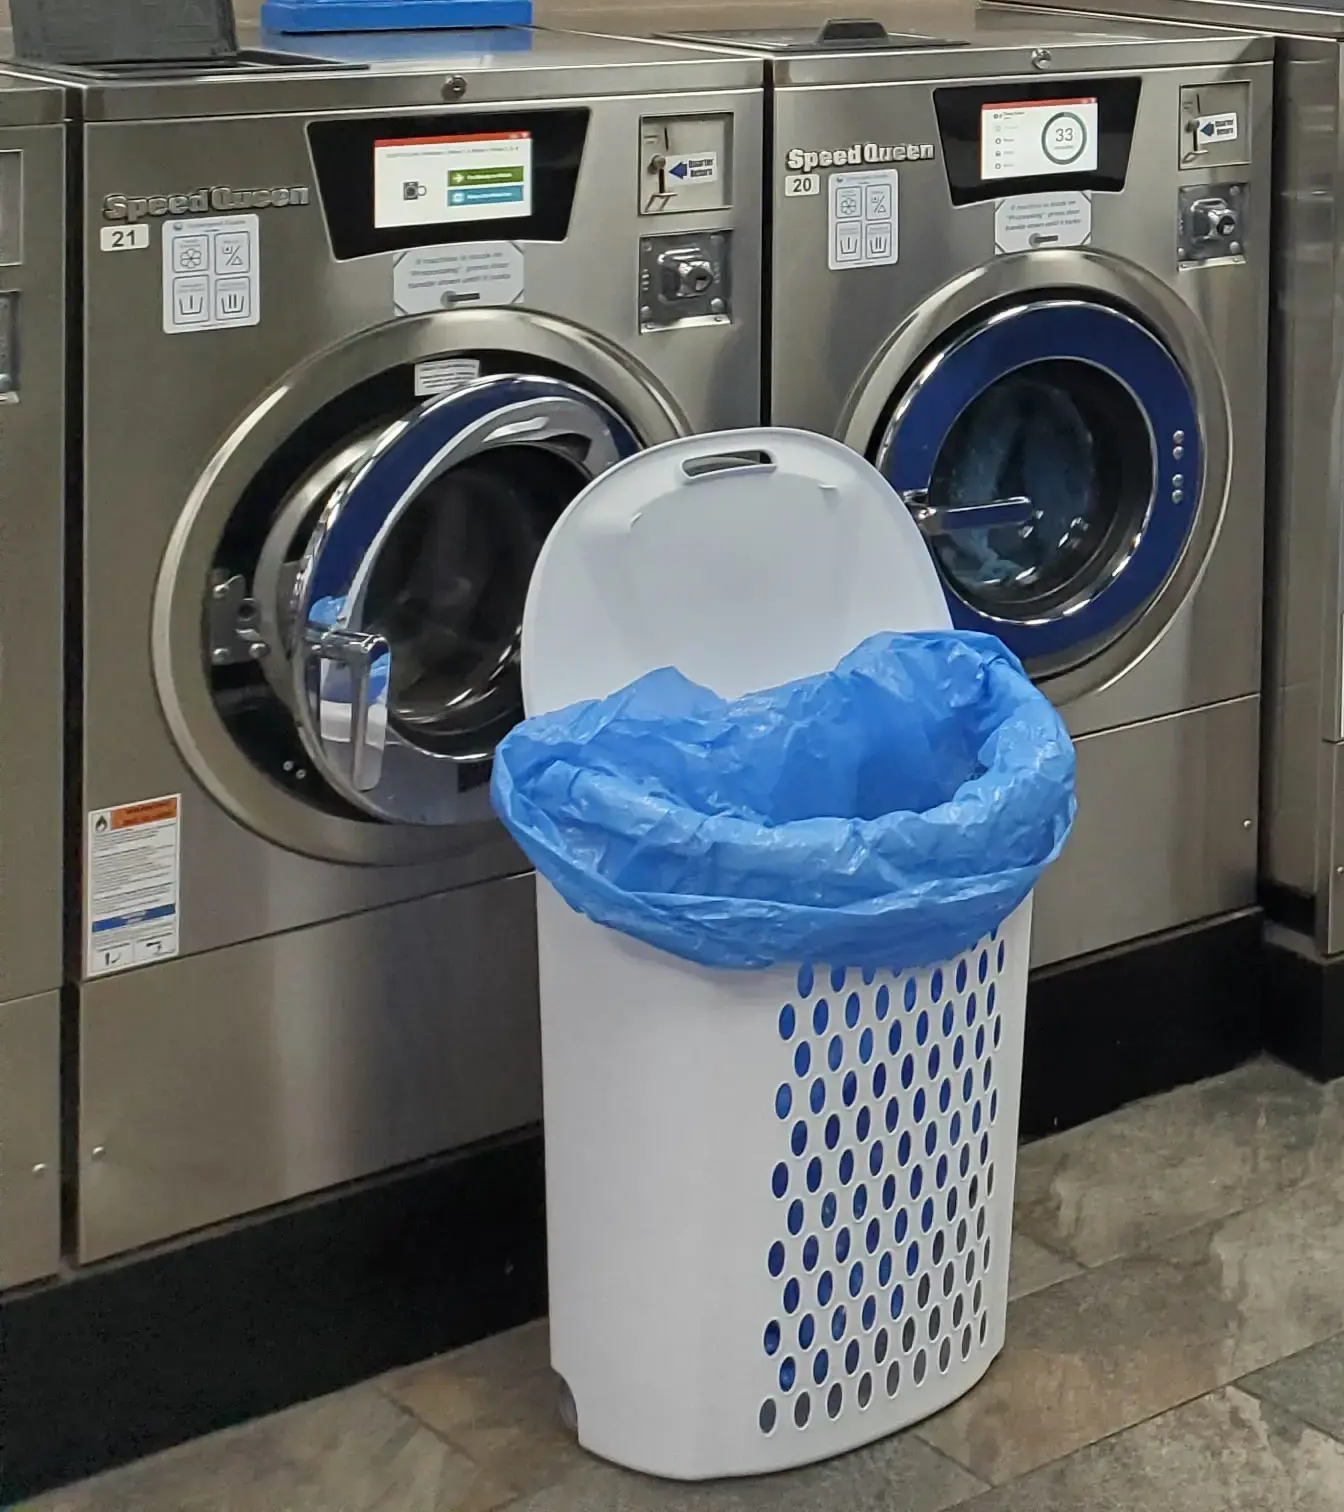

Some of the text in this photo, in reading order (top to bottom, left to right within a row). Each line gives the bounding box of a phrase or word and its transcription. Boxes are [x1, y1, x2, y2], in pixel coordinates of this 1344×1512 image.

[1055, 127, 1074, 142] 33
[787, 143, 935, 172] Speed Queen
[792, 177, 812, 193] 20
[102, 185, 310, 223] Speed Queen
[111, 229, 136, 248] 21
